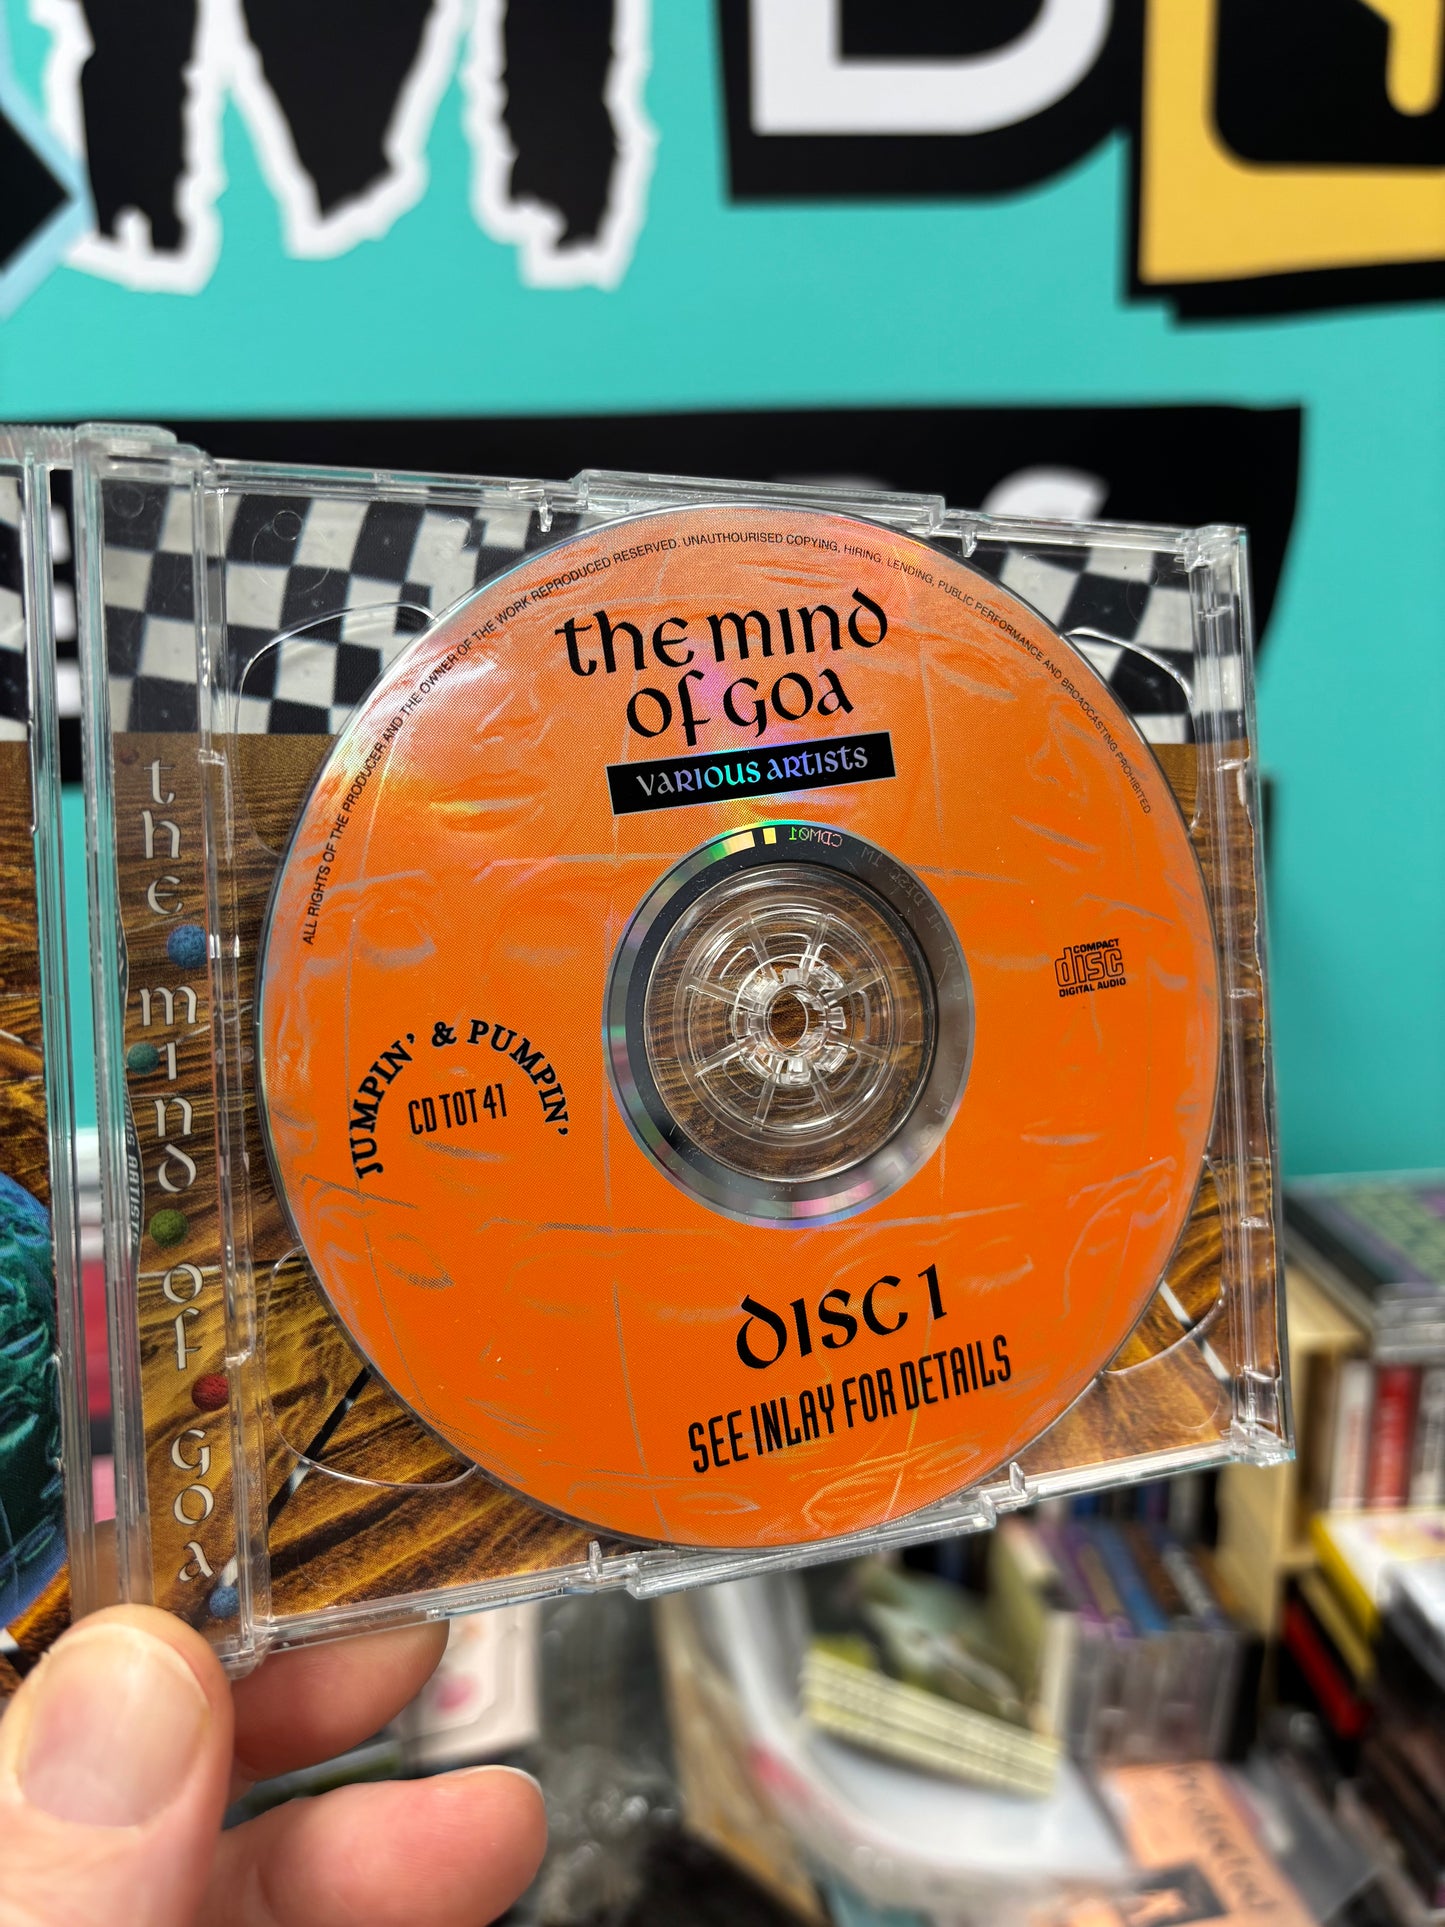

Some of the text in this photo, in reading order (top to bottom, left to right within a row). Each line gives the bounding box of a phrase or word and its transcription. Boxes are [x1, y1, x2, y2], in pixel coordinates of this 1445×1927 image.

[613, 538, 680, 564] RESERVED.
[683, 532, 784, 547] UNAUTHOURISED
[530, 557, 611, 602] REPRODUCED
[887, 557, 935, 587] LENDING,
[938, 580, 974, 606] PUBLIC
[495, 596, 531, 624] WORK
[471, 620, 497, 641] THE
[974, 602, 1044, 661] PERFORMANCE
[456, 638, 472, 656] OF
[419, 653, 459, 694] OWNER
[1042, 660, 1062, 679] AND
[399, 692, 422, 716] THE
[1061, 679, 1118, 752] BROADCASTING
[381, 716, 404, 743] AND
[342, 741, 387, 813] PRODUCER
[330, 813, 349, 840] THE
[322, 842, 337, 863] OF
[307, 864, 331, 918] RIGHTS
[302, 920, 317, 945] ALL
[1073, 938, 1119, 954] COMPACT
[1058, 977, 1126, 997] DIGITAL AUDIO
[349, 1018, 569, 1179] JUMPIN' & PUMPIN'
[482, 1083, 507, 1119] 41
[917, 1264, 947, 1321] 1
[688, 1334, 1012, 1474] SEE INLAY FOR DETAILS
